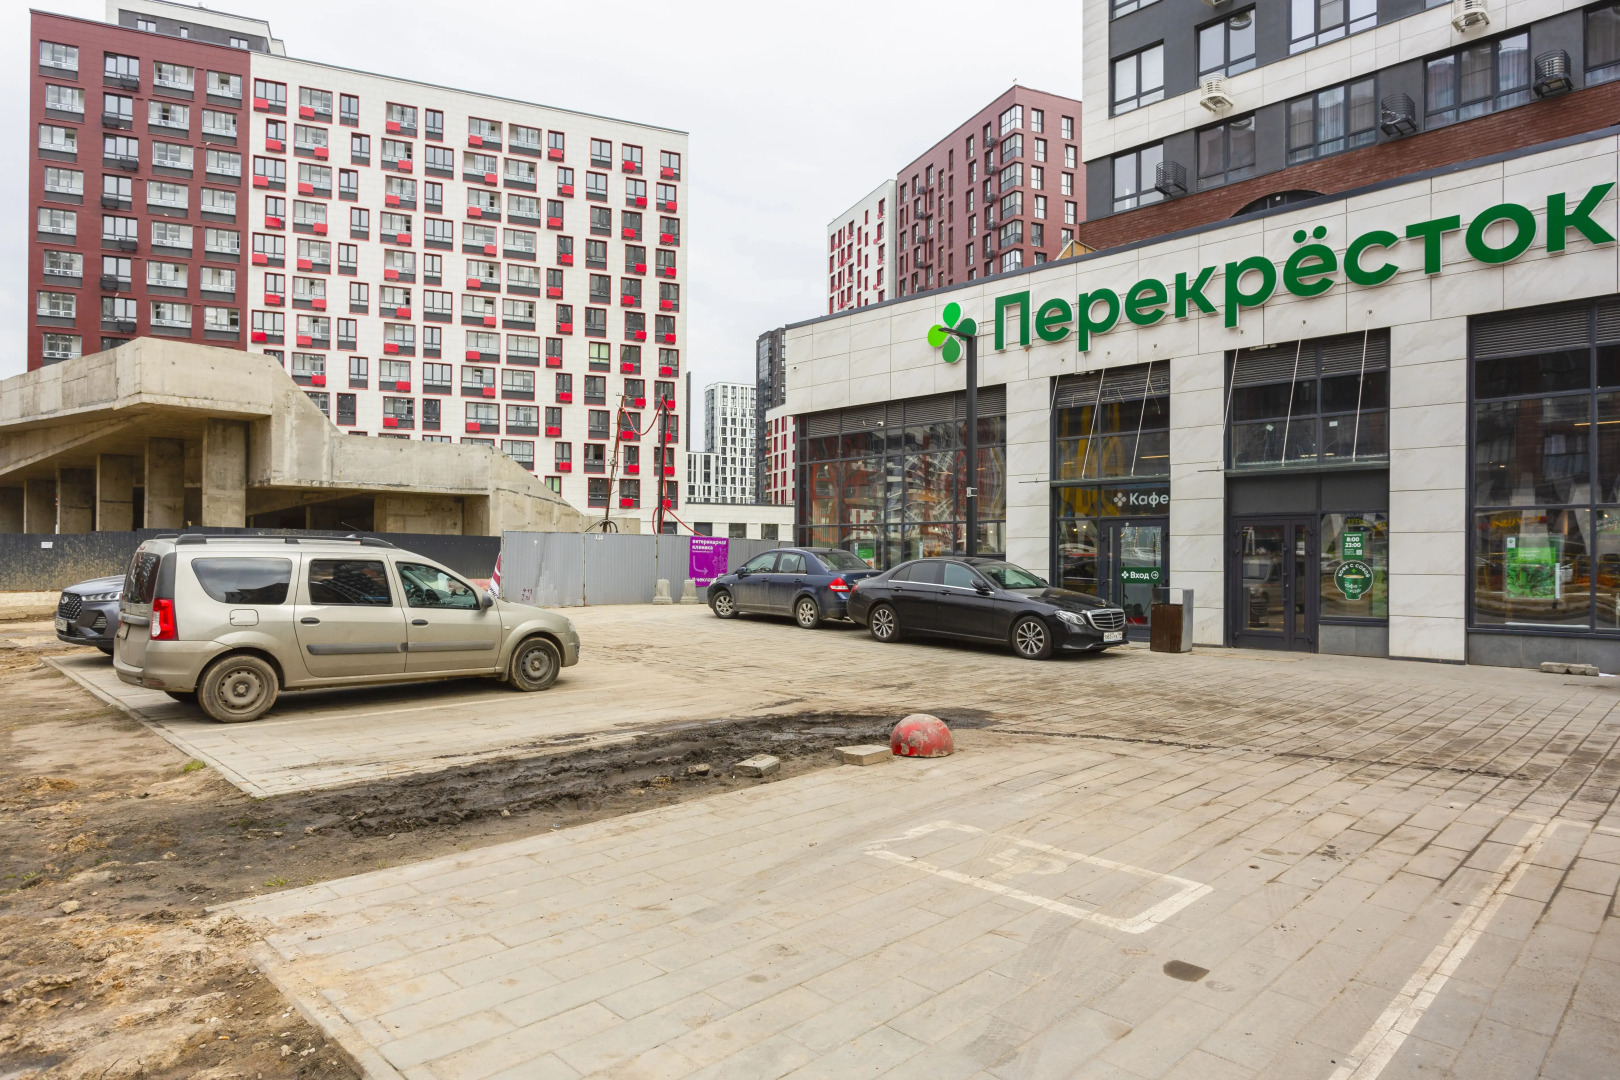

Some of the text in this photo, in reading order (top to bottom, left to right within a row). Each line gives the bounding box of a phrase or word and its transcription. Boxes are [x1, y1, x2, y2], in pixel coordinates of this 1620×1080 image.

[995, 182, 1616, 353] Перекрёсток
[1129, 492, 1169, 507] Кафе
[1130, 571, 1150, 579] Вход
